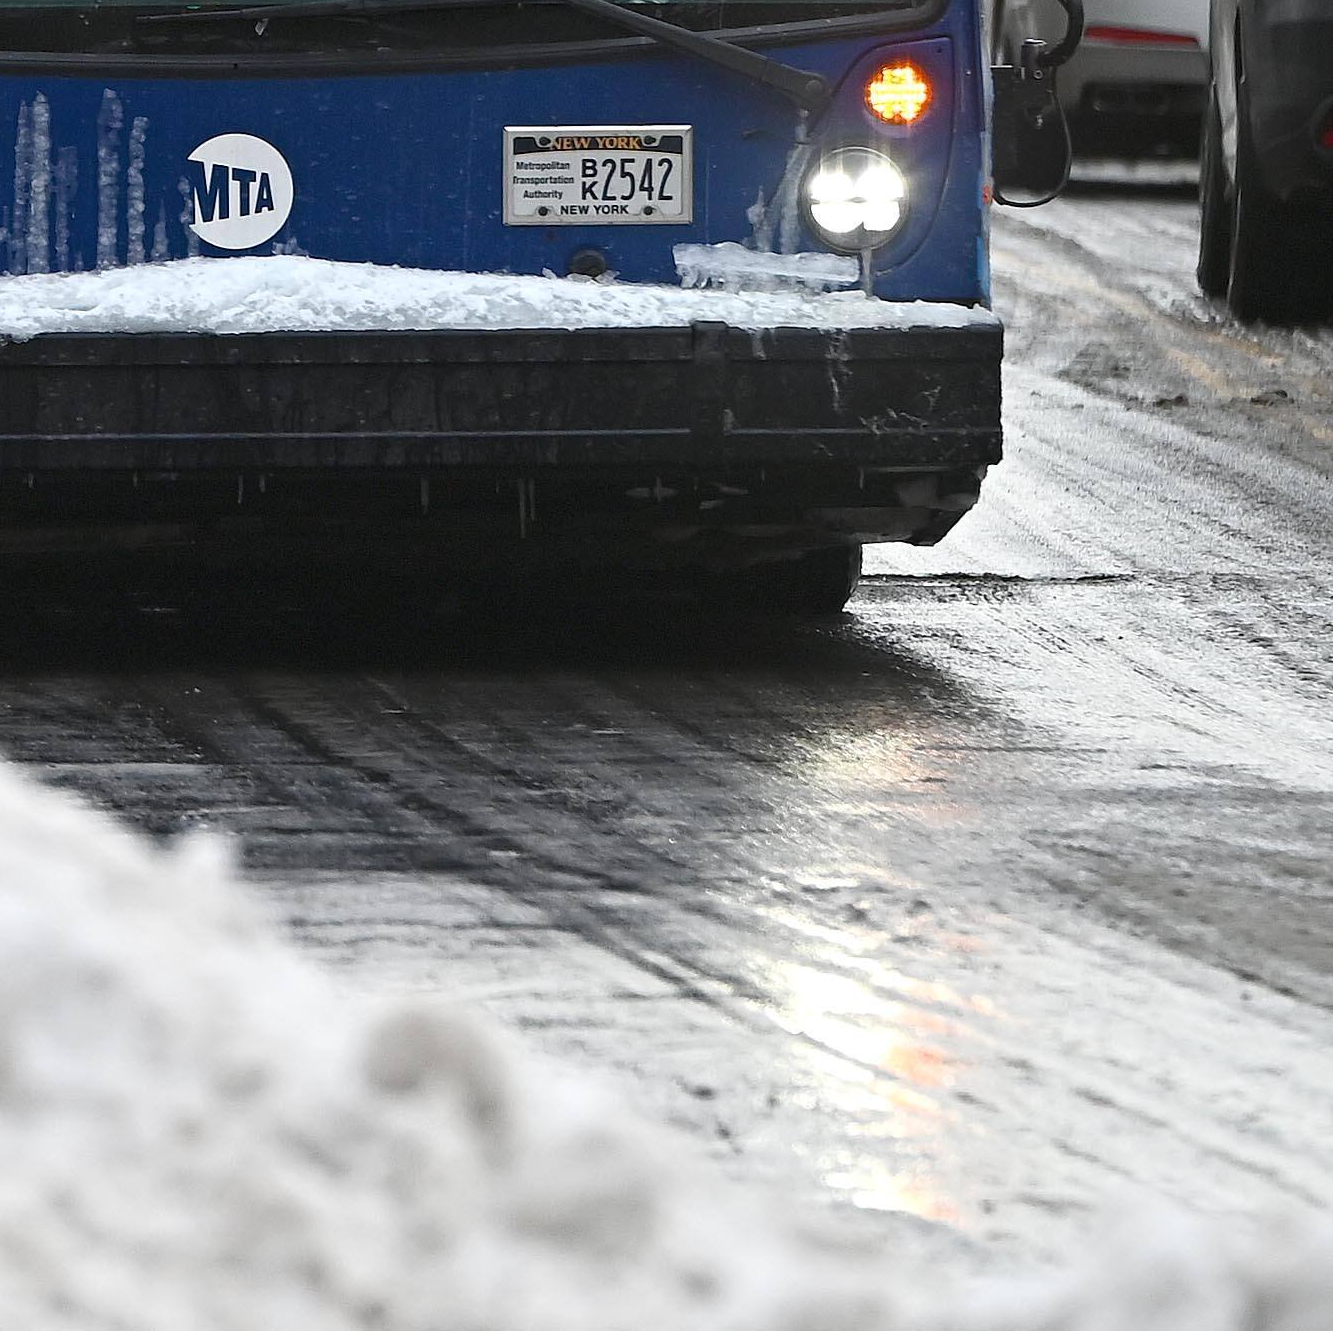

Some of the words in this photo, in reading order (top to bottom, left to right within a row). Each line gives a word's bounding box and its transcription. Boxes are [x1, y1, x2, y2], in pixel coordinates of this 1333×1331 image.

[550, 136, 591, 150] NEW
[596, 135, 642, 150] YORK
[516, 161, 571, 172] Metropolitan
[513, 175, 575, 186] Transportation
[188, 159, 275, 225] MTA
[523, 190, 564, 200] Authority
[560, 204, 590, 215] NEW
[593, 204, 630, 215] YORK
